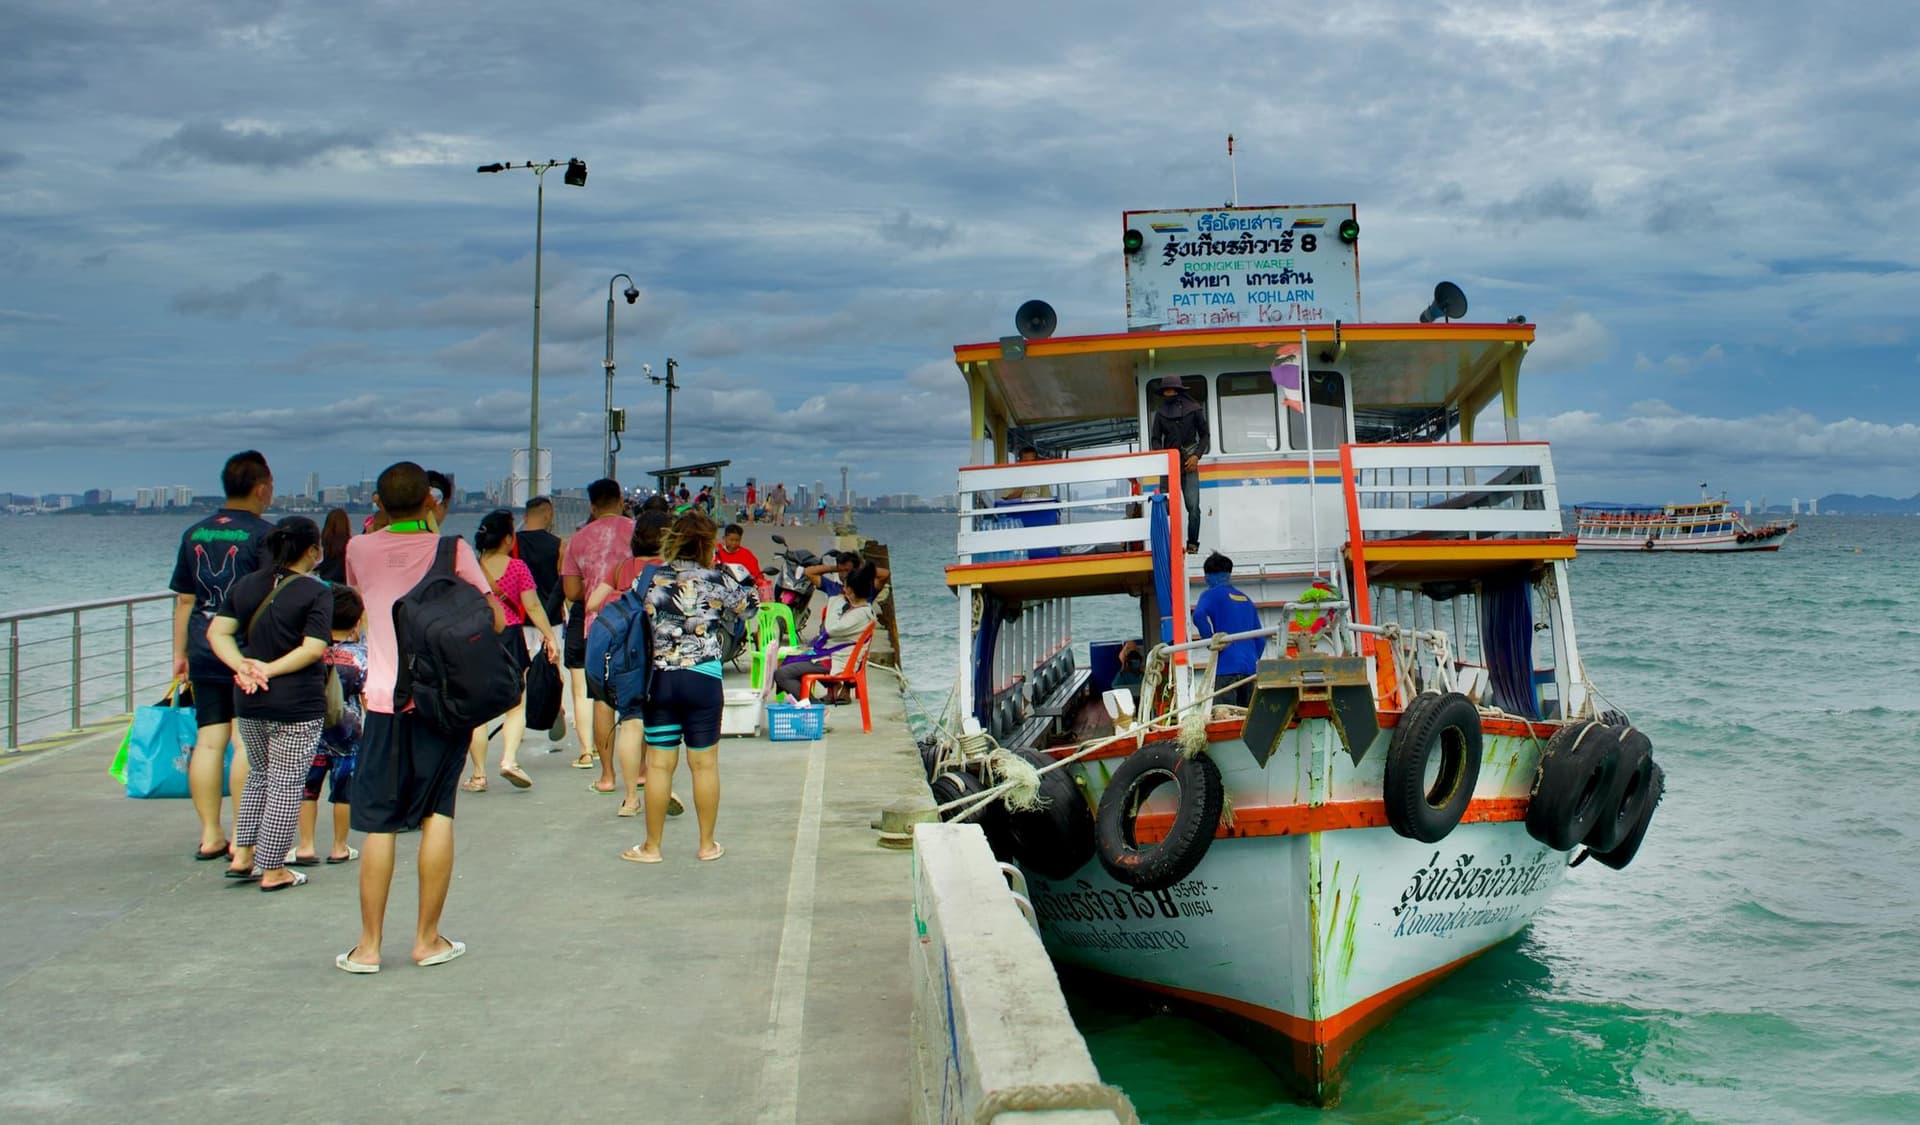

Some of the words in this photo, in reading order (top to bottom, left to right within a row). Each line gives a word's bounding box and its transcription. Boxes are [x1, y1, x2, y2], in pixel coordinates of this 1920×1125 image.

[1197, 213, 1283, 232] เรือโดยสาร
[1160, 229, 1294, 267] รุ่งเกียรติวารี
[1300, 234, 1317, 253] 8
[1180, 271, 1230, 289] พัทยา
[1246, 267, 1314, 286] เกาะล้าน
[1173, 292, 1235, 307] PATTAYA
[1248, 289, 1314, 305] KOHLARN
[1179, 900, 1213, 918] 01154
